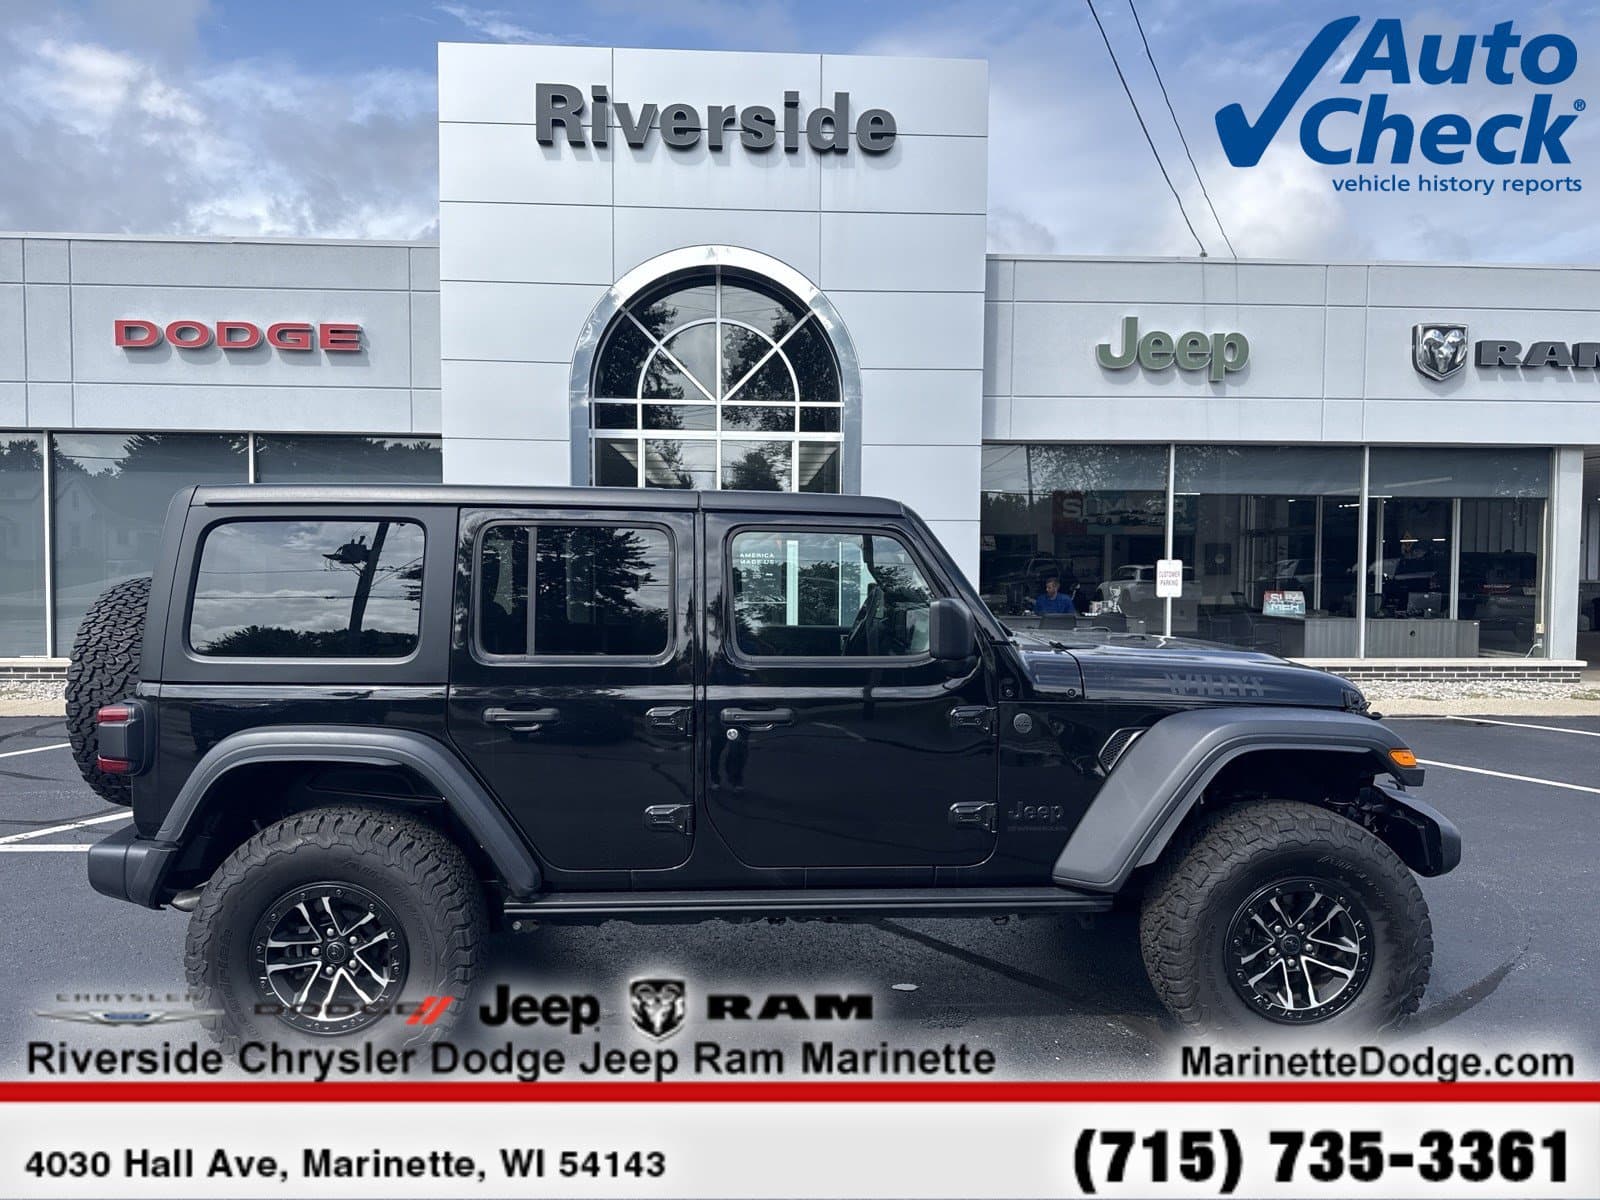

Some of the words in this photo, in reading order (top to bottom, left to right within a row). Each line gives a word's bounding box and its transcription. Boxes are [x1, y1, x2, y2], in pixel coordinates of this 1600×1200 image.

[535, 82, 898, 154] Riverside
[114, 319, 363, 351] DODGE
[1095, 316, 1250, 382] Jeep
[1163, 672, 1265, 697] WILLYS
[1007, 800, 1065, 823] Jeep
